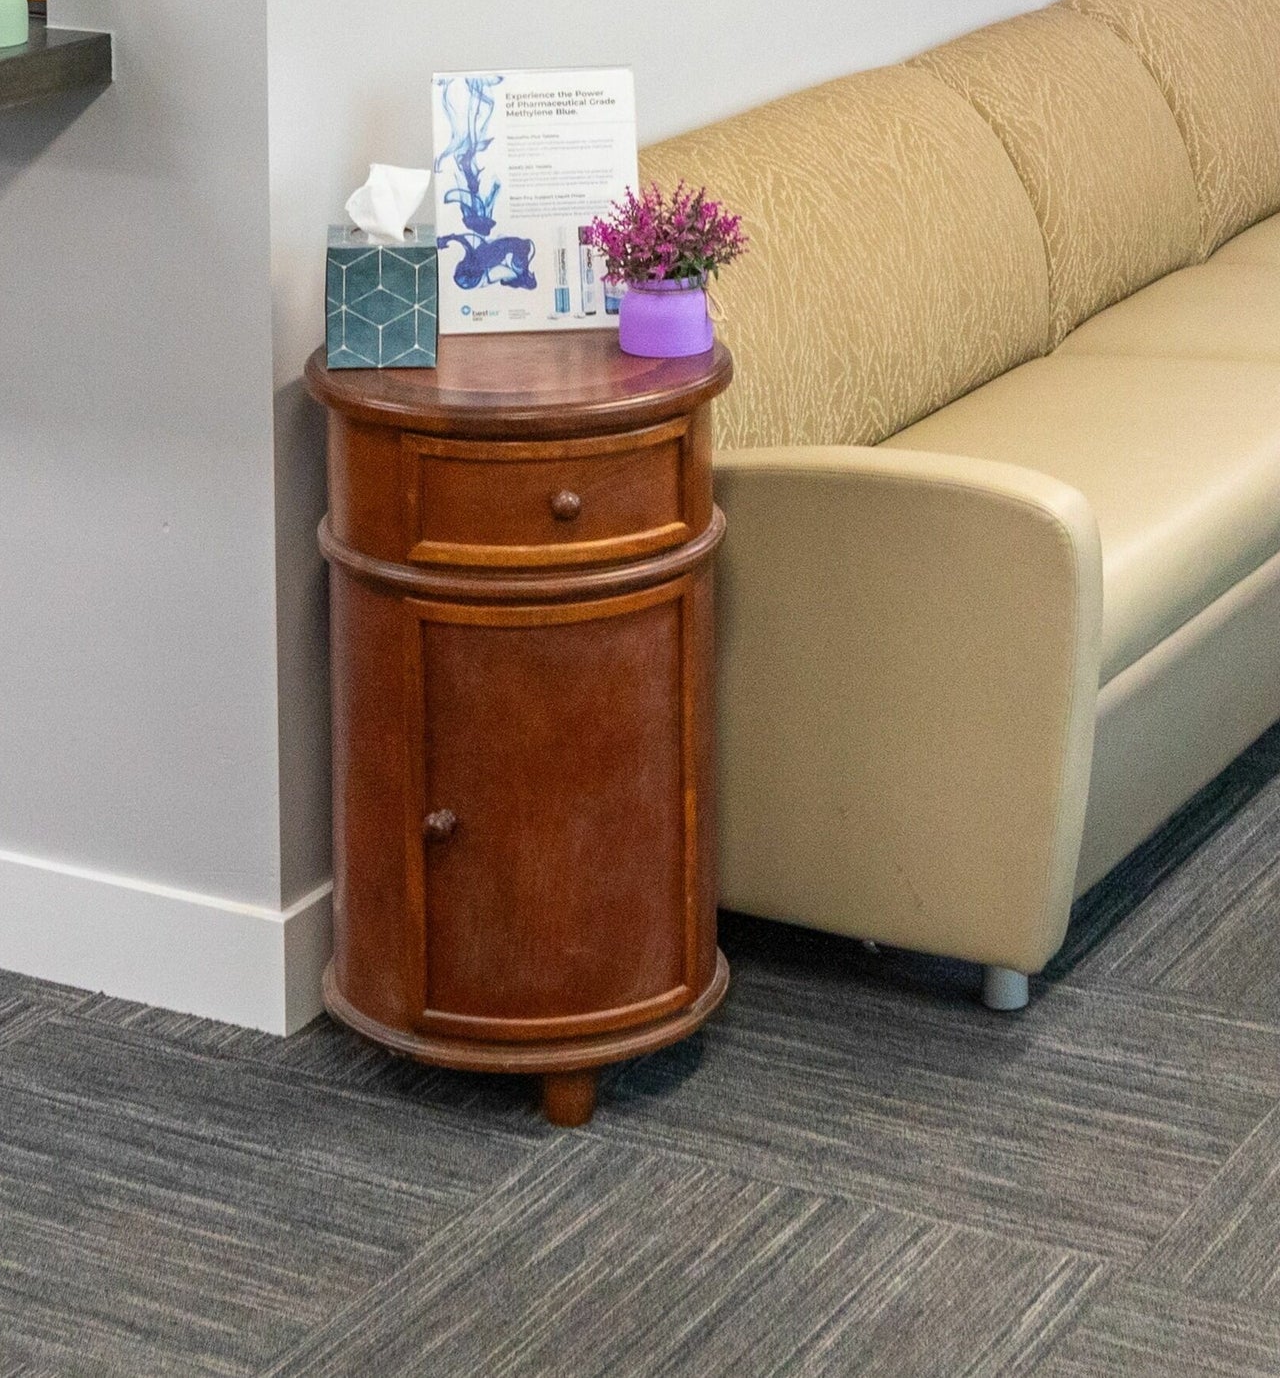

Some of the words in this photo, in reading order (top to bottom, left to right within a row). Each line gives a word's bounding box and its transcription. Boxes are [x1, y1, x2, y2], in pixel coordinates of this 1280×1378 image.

[505, 91, 555, 101] Experience
[575, 89, 604, 97] Power
[505, 100, 515, 109] of
[517, 98, 587, 108] Pharmaceutical
[589, 97, 616, 105] Grade
[506, 109, 553, 118] Methylene
[556, 108, 578, 116] Blue.
